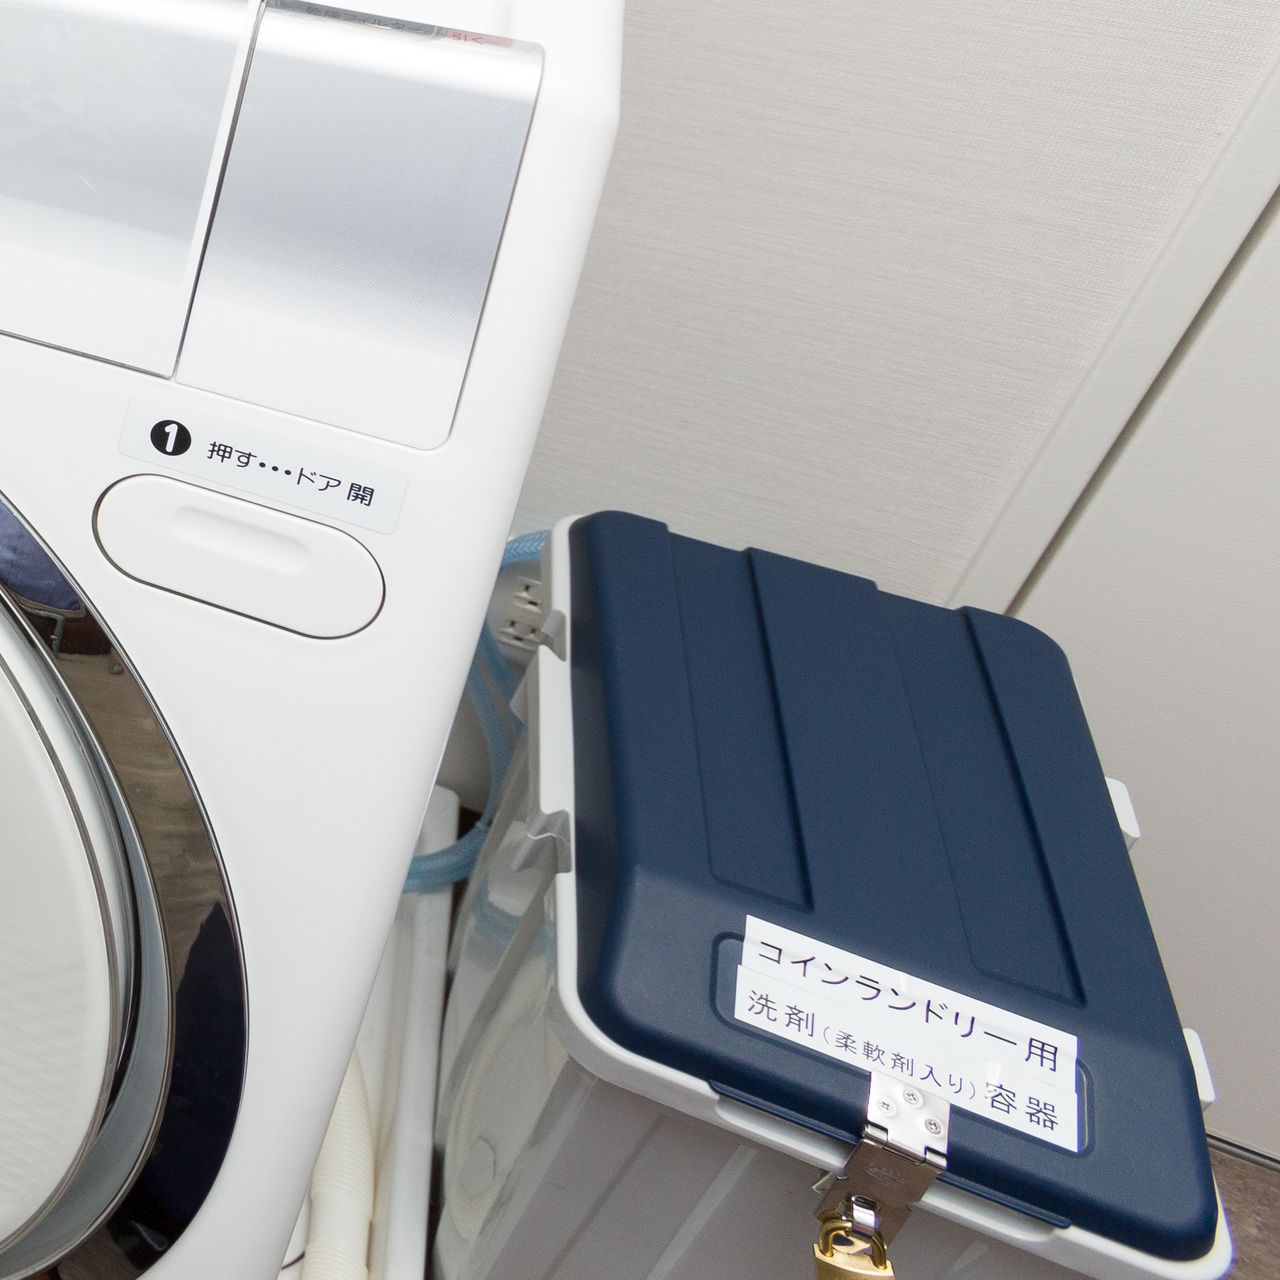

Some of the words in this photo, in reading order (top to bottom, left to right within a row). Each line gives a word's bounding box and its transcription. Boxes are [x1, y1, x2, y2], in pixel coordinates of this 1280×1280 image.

[757, 939, 1059, 1073] コインランドリー用
